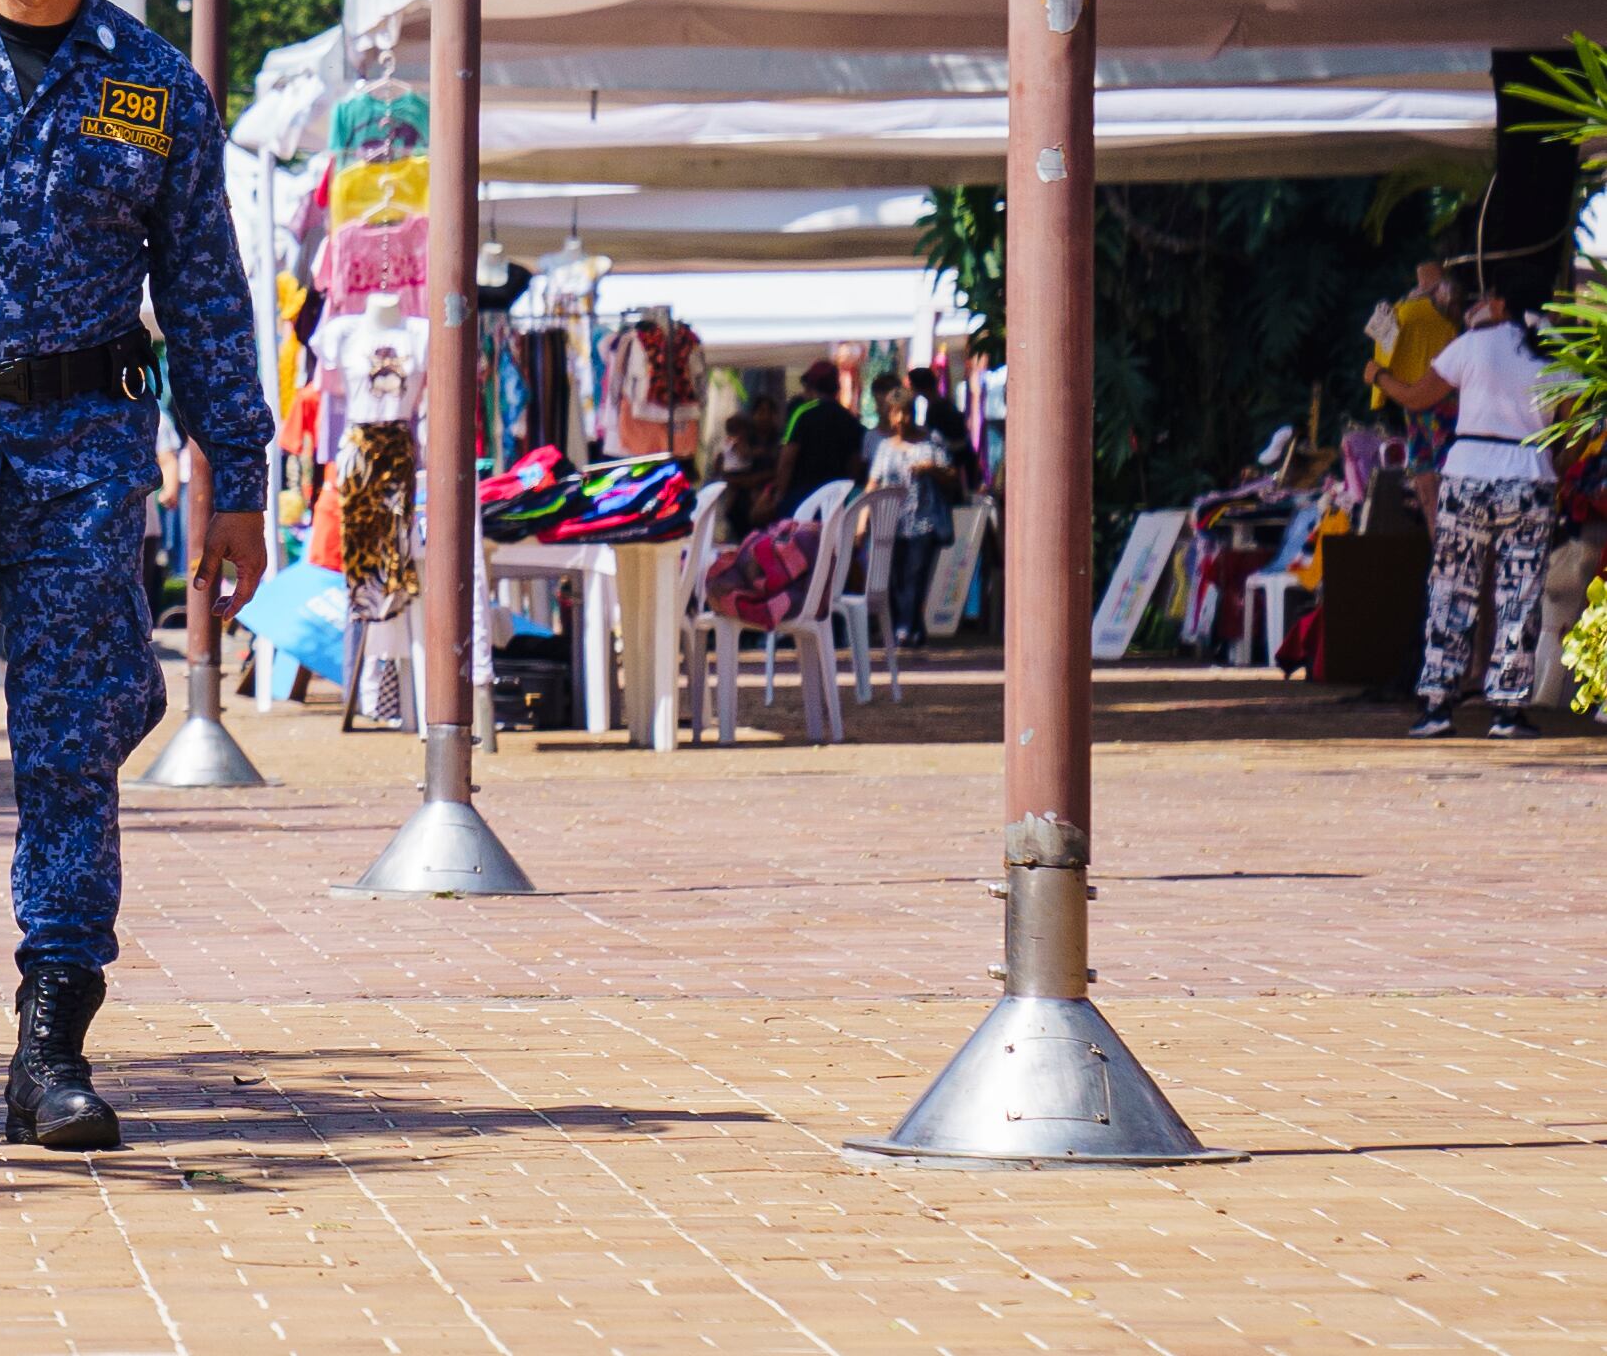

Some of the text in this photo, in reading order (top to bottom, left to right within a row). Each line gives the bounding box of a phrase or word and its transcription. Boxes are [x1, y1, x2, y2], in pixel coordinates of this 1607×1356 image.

[110, 89, 157, 122] 298
[86, 121, 102, 134] M.
[104, 123, 158, 145] CHIQUITO
